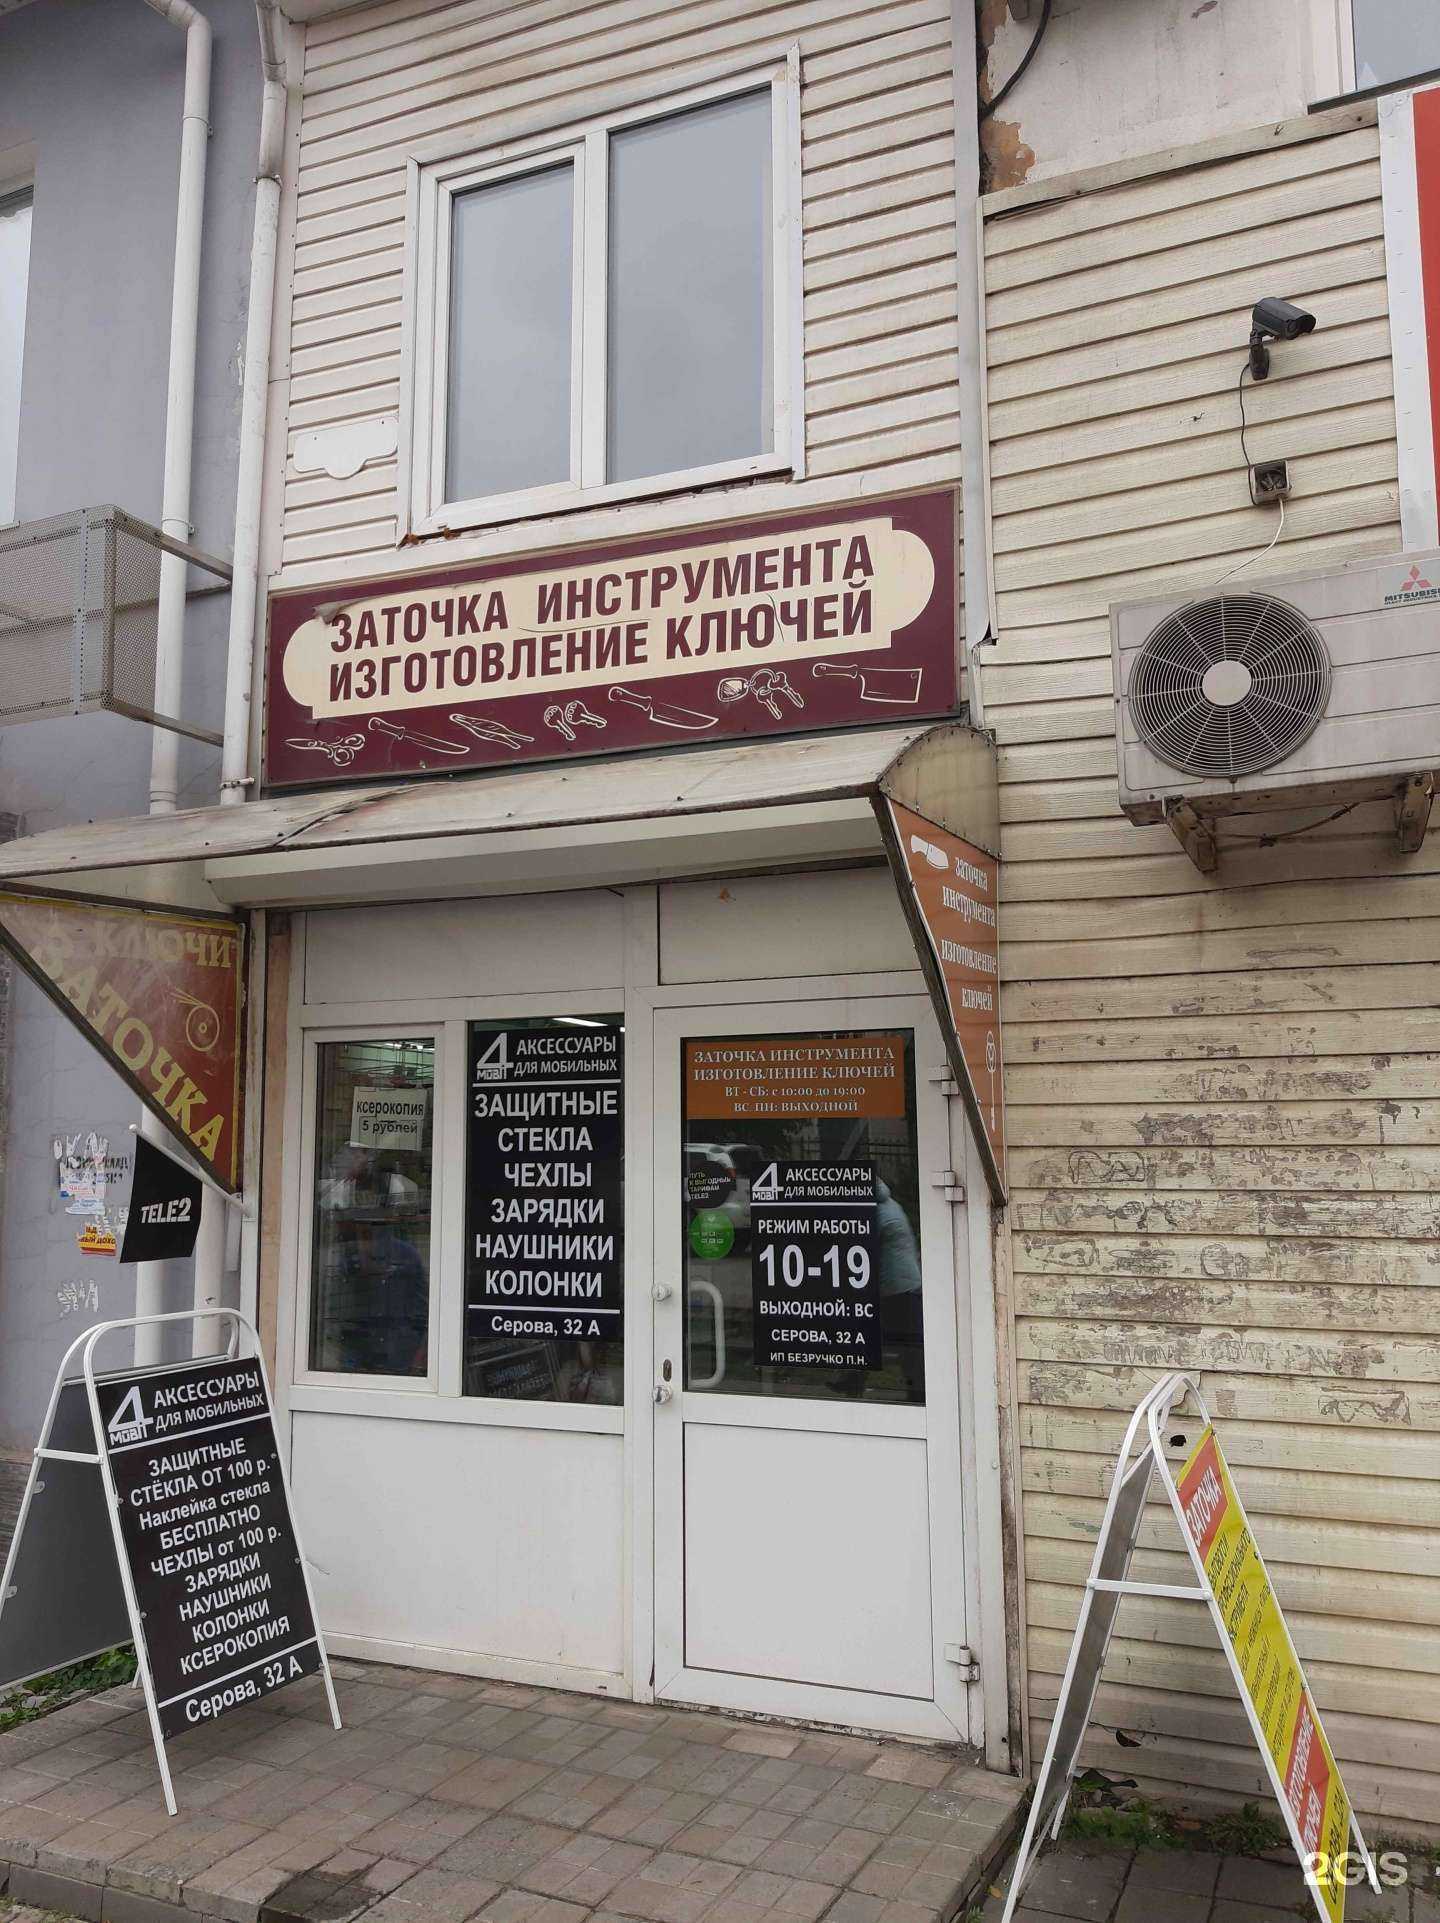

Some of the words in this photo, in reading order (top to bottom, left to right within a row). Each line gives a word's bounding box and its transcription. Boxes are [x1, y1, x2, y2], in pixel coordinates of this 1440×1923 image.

[331, 590, 509, 653] ЗАТОЧКА
[537, 534, 875, 625] ИНСТРУМЕНТА
[1384, 587, 1440, 602] MITSUBIS
[329, 622, 649, 702] ИЗГОТОВЛЕНИЕ
[665, 579, 872, 660] КЛЮЧЕЙ
[954, 856, 988, 892] заточка
[942, 886, 996, 928] инструмента
[941, 939, 997, 974] изготовление
[961, 985, 993, 1011] ключей
[516, 1036, 616, 1055] АКСЕССУАРЫ
[694, 1050, 766, 1063] ЗАТОЧКА
[770, 1047, 895, 1062] ИНСТРУМЕНТА
[514, 1061, 538, 1077] ДЛЯ
[540, 1059, 617, 1074] МОБИЛЬНЫХ
[694, 1066, 818, 1081] ИЗГОТОВЛЕНИЕ
[822, 1063, 896, 1079] КЛЮЧЕЙ
[474, 1090, 618, 1121] ЗАЩИТНЫЕ
[725, 1086, 740, 1097] ВТ
[781, 1087, 813, 1096] 10:00
[816, 1088, 830, 1097] до
[833, 1087, 866, 1097] 19:00
[356, 1101, 424, 1117] ксерокопия
[782, 1099, 858, 1113] ВЫХОДНОЙ
[362, 1120, 369, 1131] 5
[372, 1120, 418, 1134] рублей
[498, 1126, 594, 1152] СТЕКЛА
[504, 1162, 592, 1187] ЧЕХЛЫ
[786, 1168, 871, 1181] АКСЕССУАРЫ
[784, 1186, 804, 1198] ДЛЯ
[807, 1186, 873, 1196] МОБИЛЬНЫХ
[140, 1197, 191, 1223] TELE2
[490, 1198, 604, 1228] ЗАРЯДКИ
[758, 1219, 809, 1234] РЕЖИМ
[814, 1219, 870, 1234] РАБОТЫ
[475, 1234, 614, 1260] НАУШНИКИ
[759, 1244, 870, 1289] 10-19
[485, 1270, 602, 1298] КОЛОНКИ
[760, 1299, 850, 1318] ВЫХОДНОЙ:
[854, 1303, 873, 1317] ВС
[491, 1315, 558, 1336] Серова,
[563, 1319, 583, 1335] 32
[587, 1319, 601, 1335] А
[771, 1329, 832, 1344] СЕРОВА,
[836, 1331, 851, 1344] 32
[855, 1332, 865, 1344] А
[770, 1352, 784, 1361] ИП
[788, 1353, 843, 1364] БЕЗРУЧКО
[846, 1355, 868, 1365] П.Н.
[154, 1371, 259, 1408] АКСЕССУАРЫ
[156, 1414, 182, 1433] ДЛЯ
[185, 1394, 264, 1423] МОБИЛЬНЫХ
[149, 1438, 246, 1477] ЗАЩИТНЫЕ
[130, 1475, 198, 1506] СТЁКЛА
[202, 1467, 223, 1486] ОТ
[228, 1460, 253, 1479] 100
[257, 1459, 270, 1475] р.
[140, 1498, 217, 1530] Наклейка
[221, 1481, 271, 1506] стекла
[1186, 1465, 1221, 1546] ЗАТОЧКА
[160, 1505, 261, 1550] БЕСПЛАТНО
[151, 1543, 214, 1577] ЧЕХЛЫ
[218, 1540, 234, 1556] от
[238, 1528, 264, 1549] 100
[268, 1527, 281, 1543] р.
[185, 1552, 261, 1593] ЗАРЯДКИ
[179, 1573, 272, 1622] НАУШНИКИ
[192, 1599, 270, 1643] КОЛОНКИ
[180, 1616, 290, 1676] КСЕРОКОПИЯ
[185, 1680, 262, 1722] Серова,
[264, 1662, 286, 1688] 32
[289, 1656, 303, 1678] А
